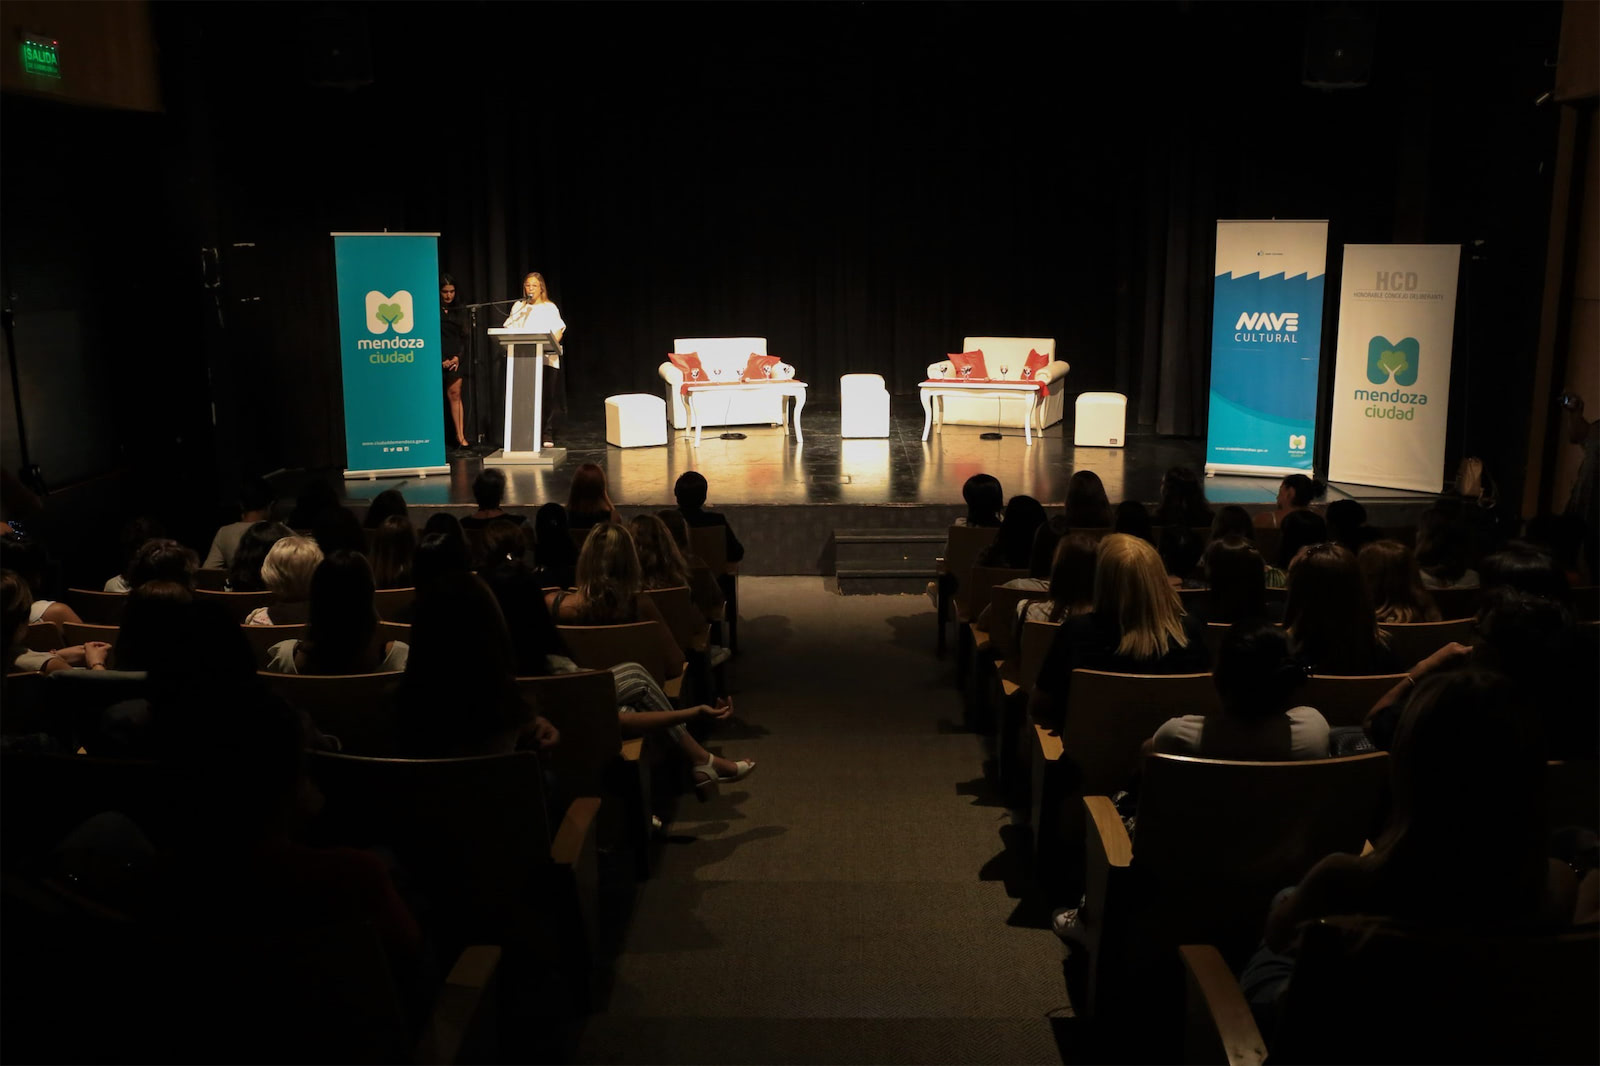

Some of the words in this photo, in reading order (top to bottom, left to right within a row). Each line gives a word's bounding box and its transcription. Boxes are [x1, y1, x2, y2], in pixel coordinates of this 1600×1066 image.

[26, 47, 58, 65] SALIDA
[1376, 271, 1419, 291] HCD
[1353, 291, 1383, 299] HONORABLE
[1235, 311, 1299, 332] NAVE
[357, 336, 425, 350] mendoza
[1234, 332, 1298, 343] CULTURAL
[369, 350, 414, 364] ciudad
[1354, 388, 1428, 406] mendoza
[1364, 404, 1415, 421] ciudad
